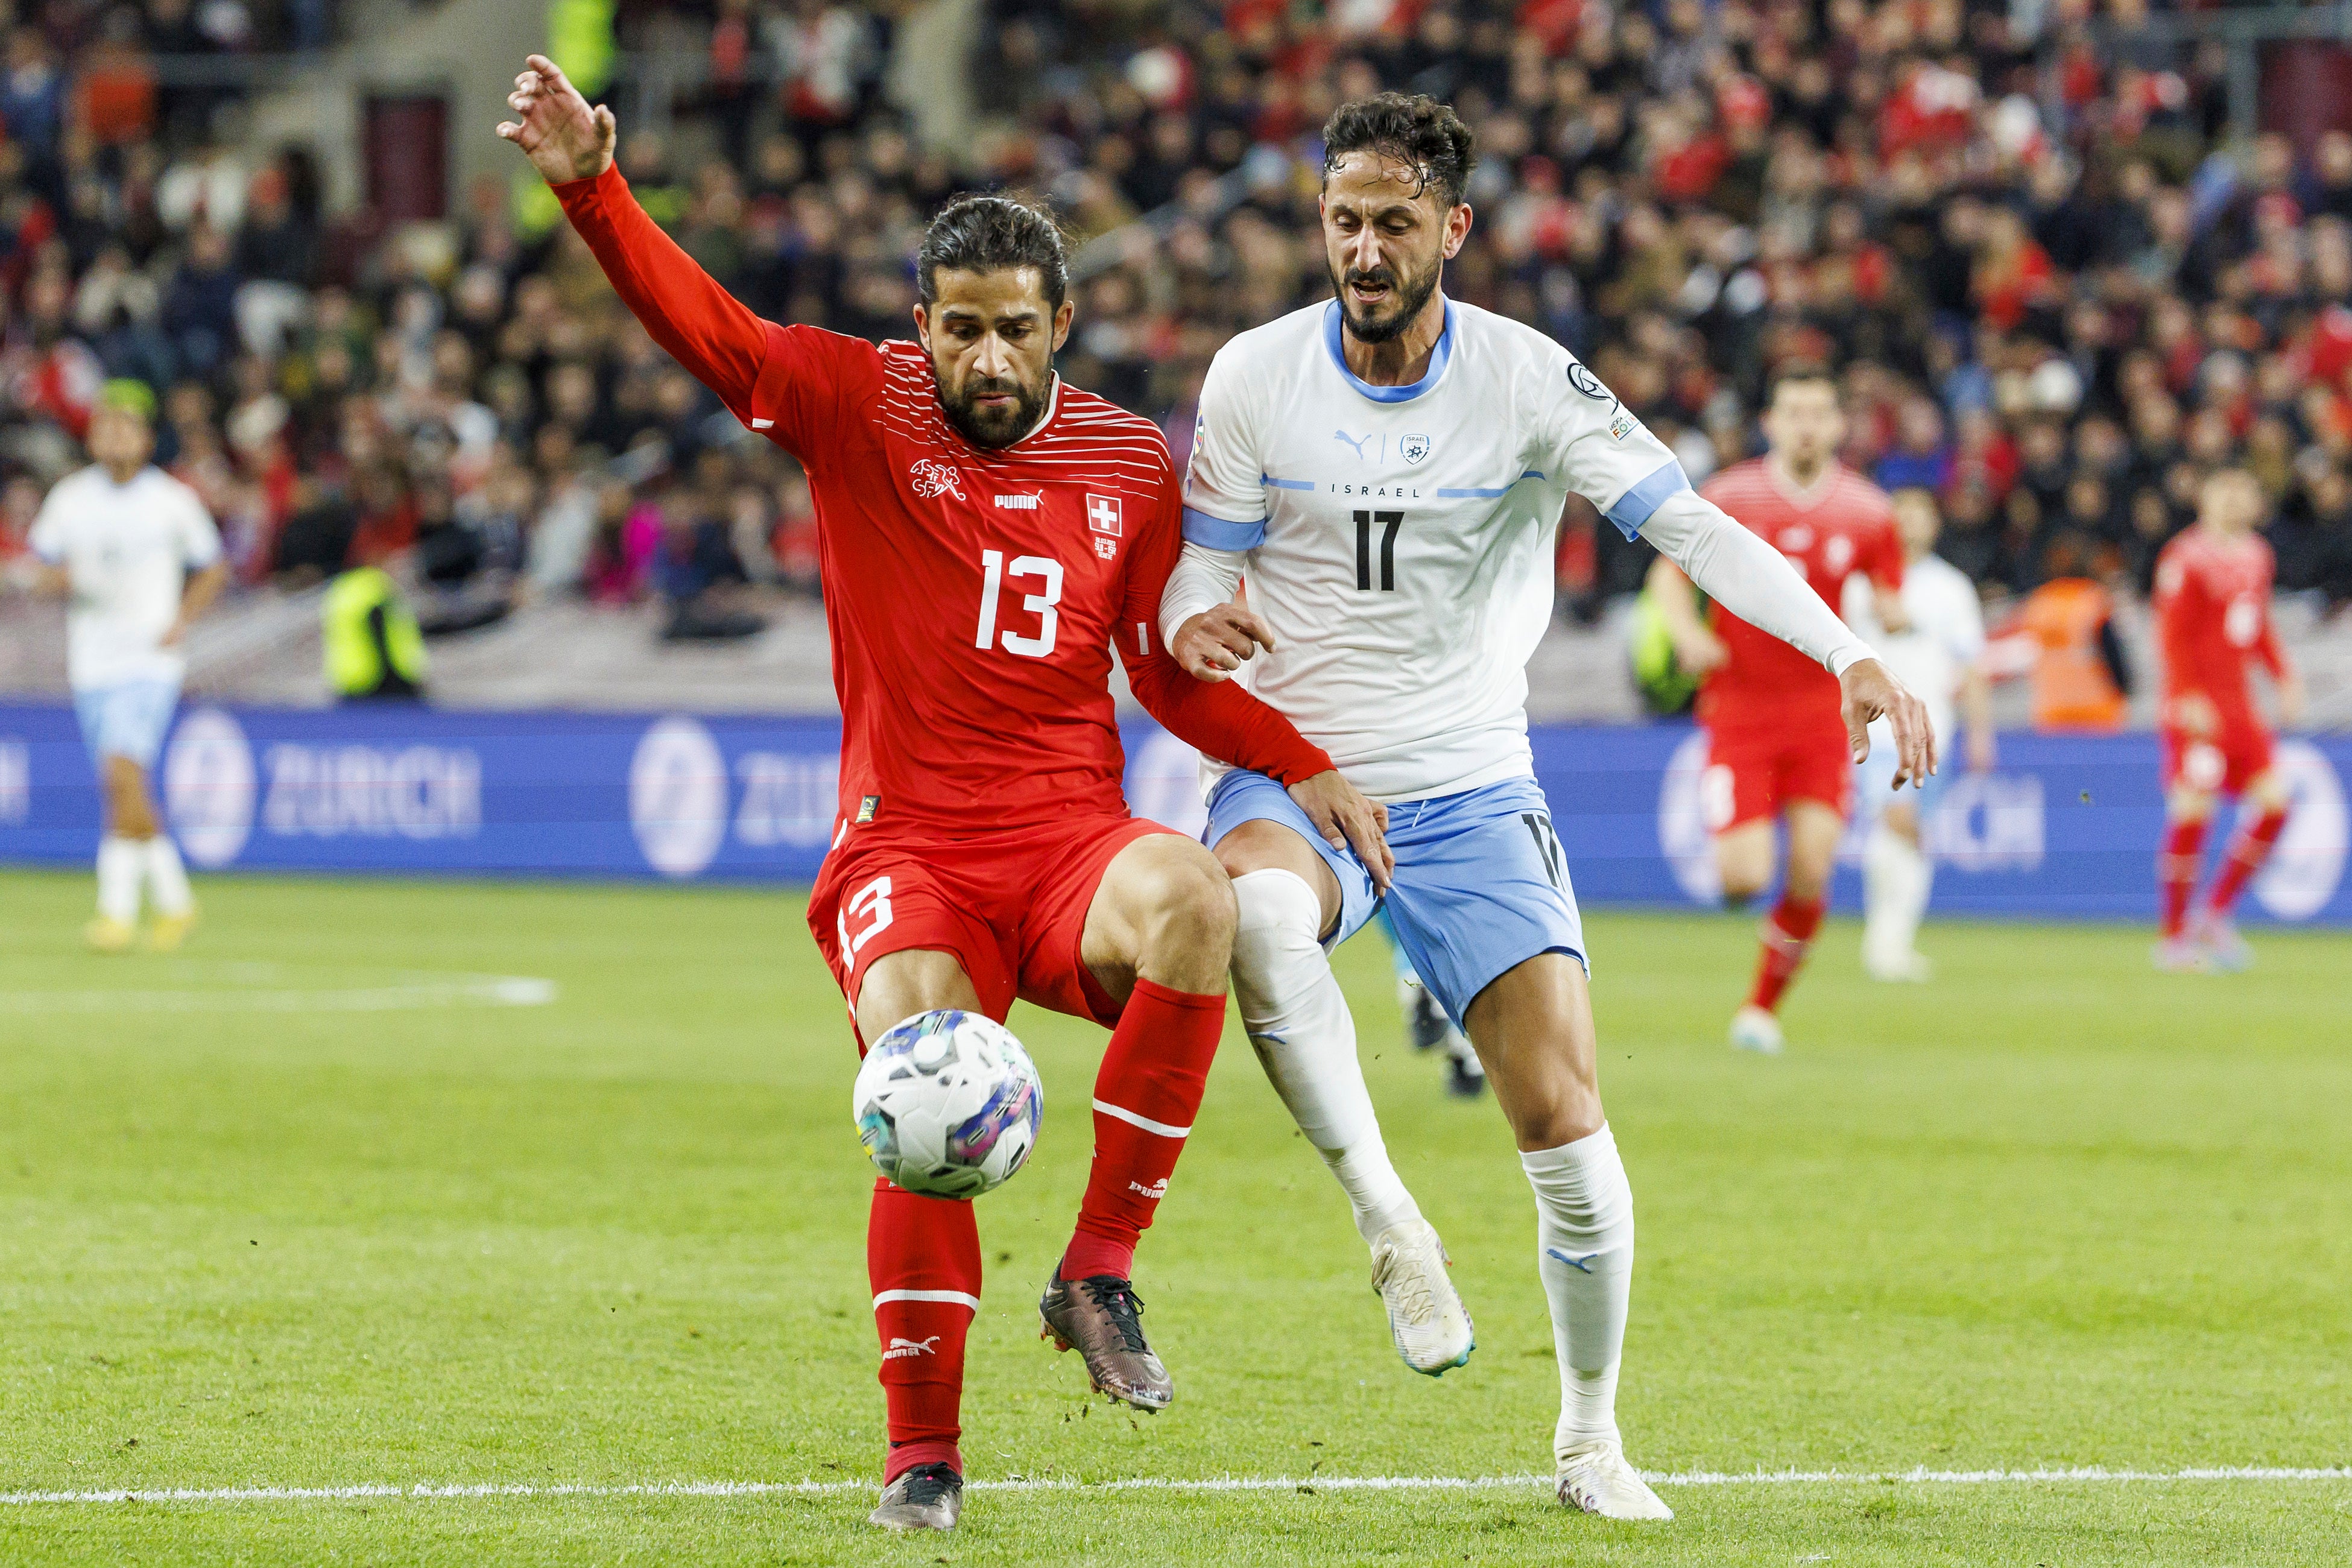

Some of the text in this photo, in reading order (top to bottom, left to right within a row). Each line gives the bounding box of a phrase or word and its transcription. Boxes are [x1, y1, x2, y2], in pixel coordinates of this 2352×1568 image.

[995, 495, 1037, 510] PUMA
[1332, 484, 1419, 498] ISRAEL
[1353, 510, 1405, 591] 17
[976, 549, 1064, 657] 13
[264, 744, 482, 839] ZURICH
[1521, 814, 1566, 893] 17
[837, 876, 893, 974] 13
